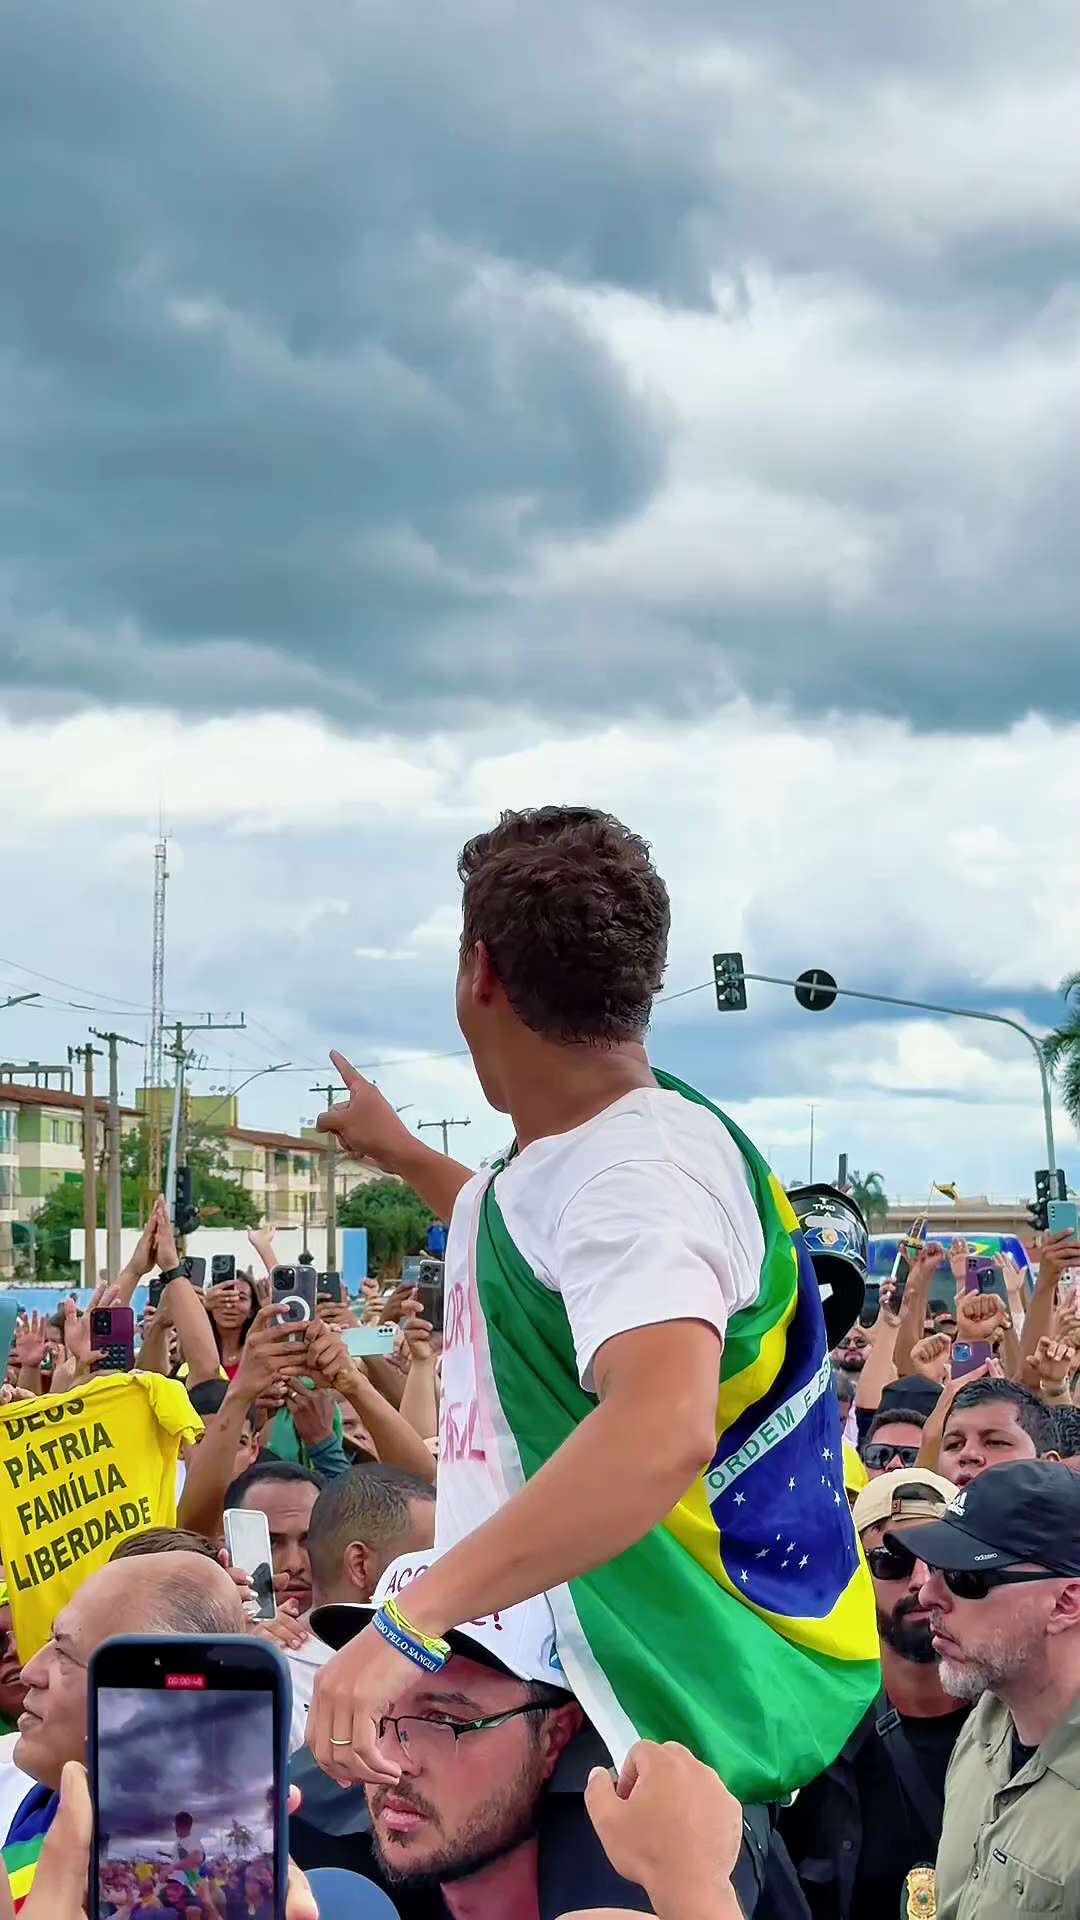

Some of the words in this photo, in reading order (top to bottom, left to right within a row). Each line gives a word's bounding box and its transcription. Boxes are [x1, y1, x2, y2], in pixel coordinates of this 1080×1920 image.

[3, 1422, 115, 1489] PÁTRIA
[708, 1405, 796, 1489] ORDEM
[803, 1390, 812, 1409] E
[17, 1463, 127, 1535] FAMÍLIA
[10, 1496, 151, 1591] LIBERDADE
[386, 1630, 409, 1650] PELO
